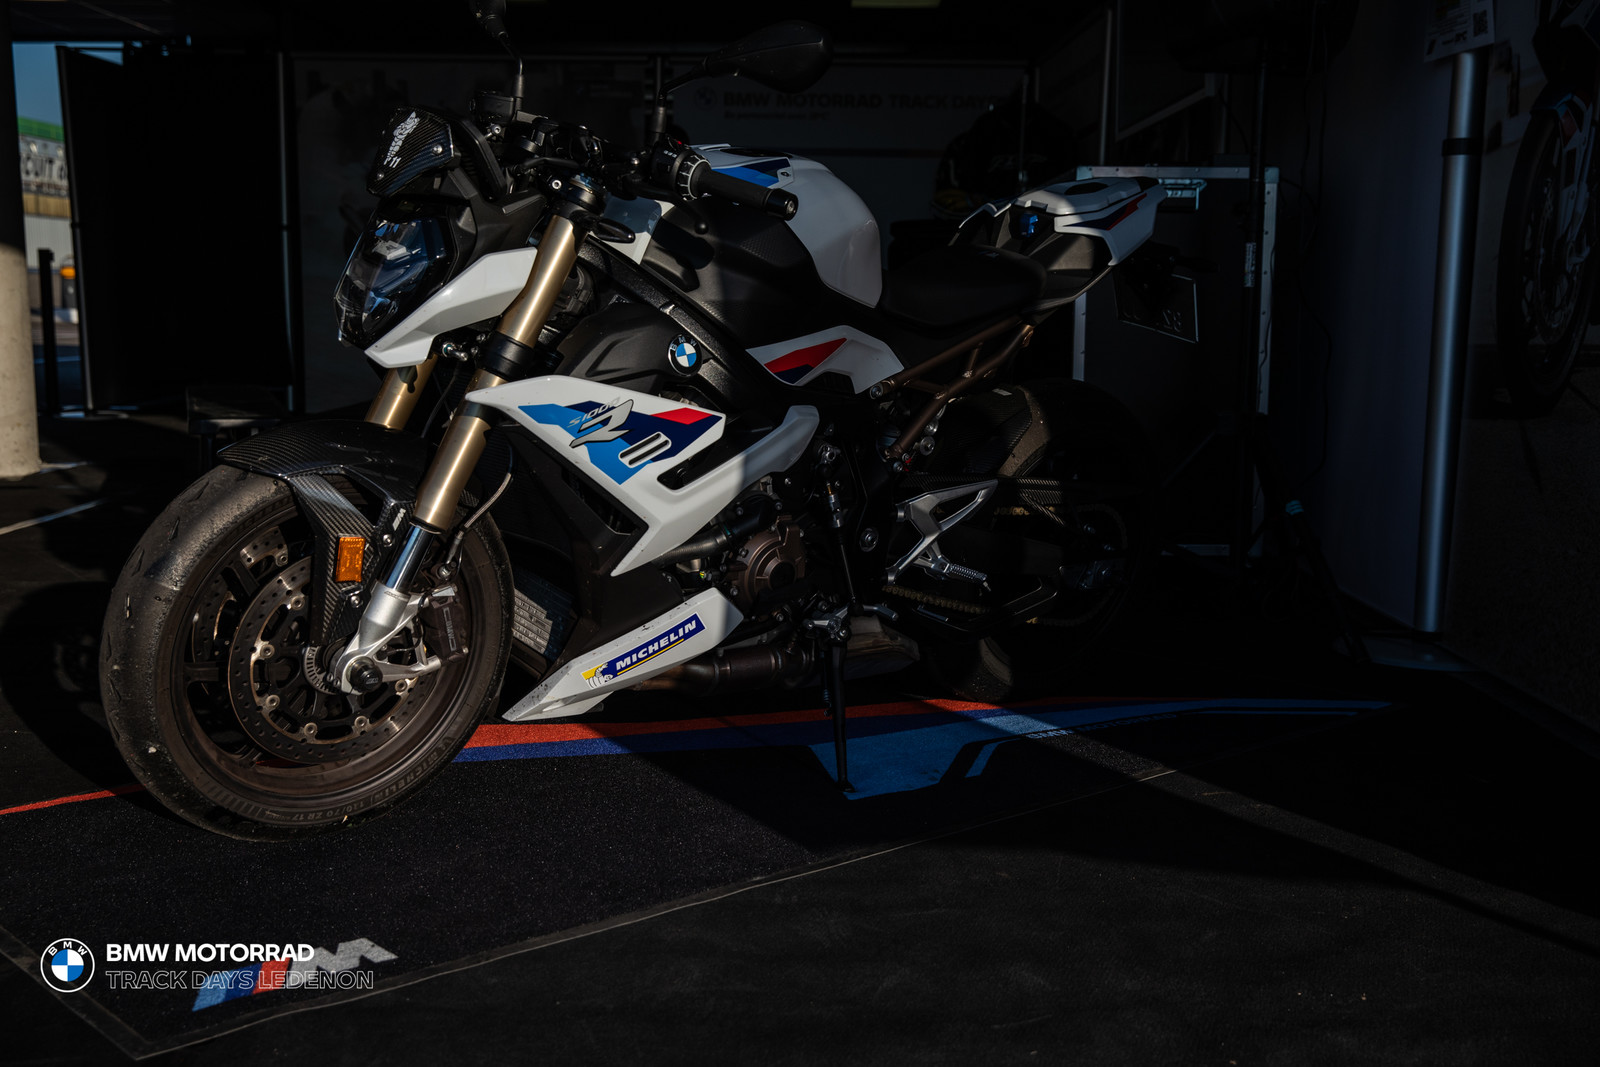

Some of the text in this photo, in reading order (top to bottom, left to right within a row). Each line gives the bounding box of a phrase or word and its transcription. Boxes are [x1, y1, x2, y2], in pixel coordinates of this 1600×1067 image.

[724, 92, 770, 107] BMW
[776, 93, 883, 108] MOTORRAD
[889, 94, 948, 110] TRACK
[669, 335, 698, 352] BMW
[615, 619, 698, 671] MICHELIN
[373, 749, 440, 801] MICHELIN
